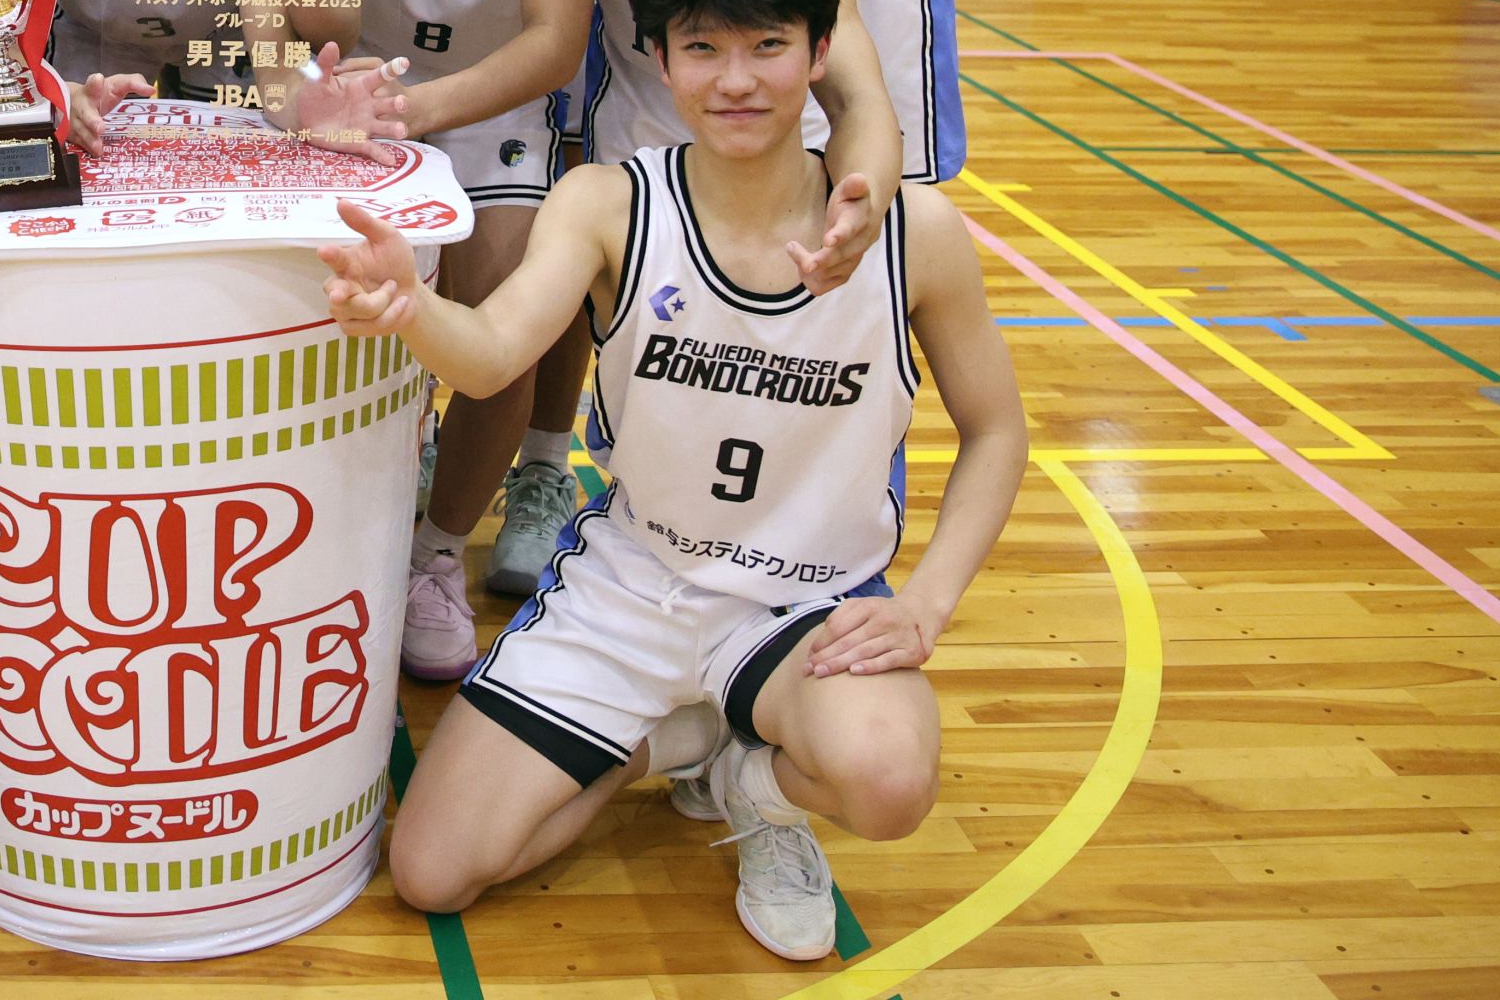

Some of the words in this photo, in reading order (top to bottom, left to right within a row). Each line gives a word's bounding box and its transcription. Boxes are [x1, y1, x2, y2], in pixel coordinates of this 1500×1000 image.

[135, 16, 177, 38] 3
[413, 21, 453, 53] 8
[186, 40, 312, 68] 男子優勝
[209, 84, 264, 109] JBA
[634, 333, 871, 408] BONDCROWS
[679, 337, 767, 366] FUJIEDA
[768, 353, 839, 377] MEISEI
[710, 437, 765, 503] 9
[646, 519, 848, 584] 鈴与システムテクノロジー
[12, 790, 247, 841] カップヌードル
